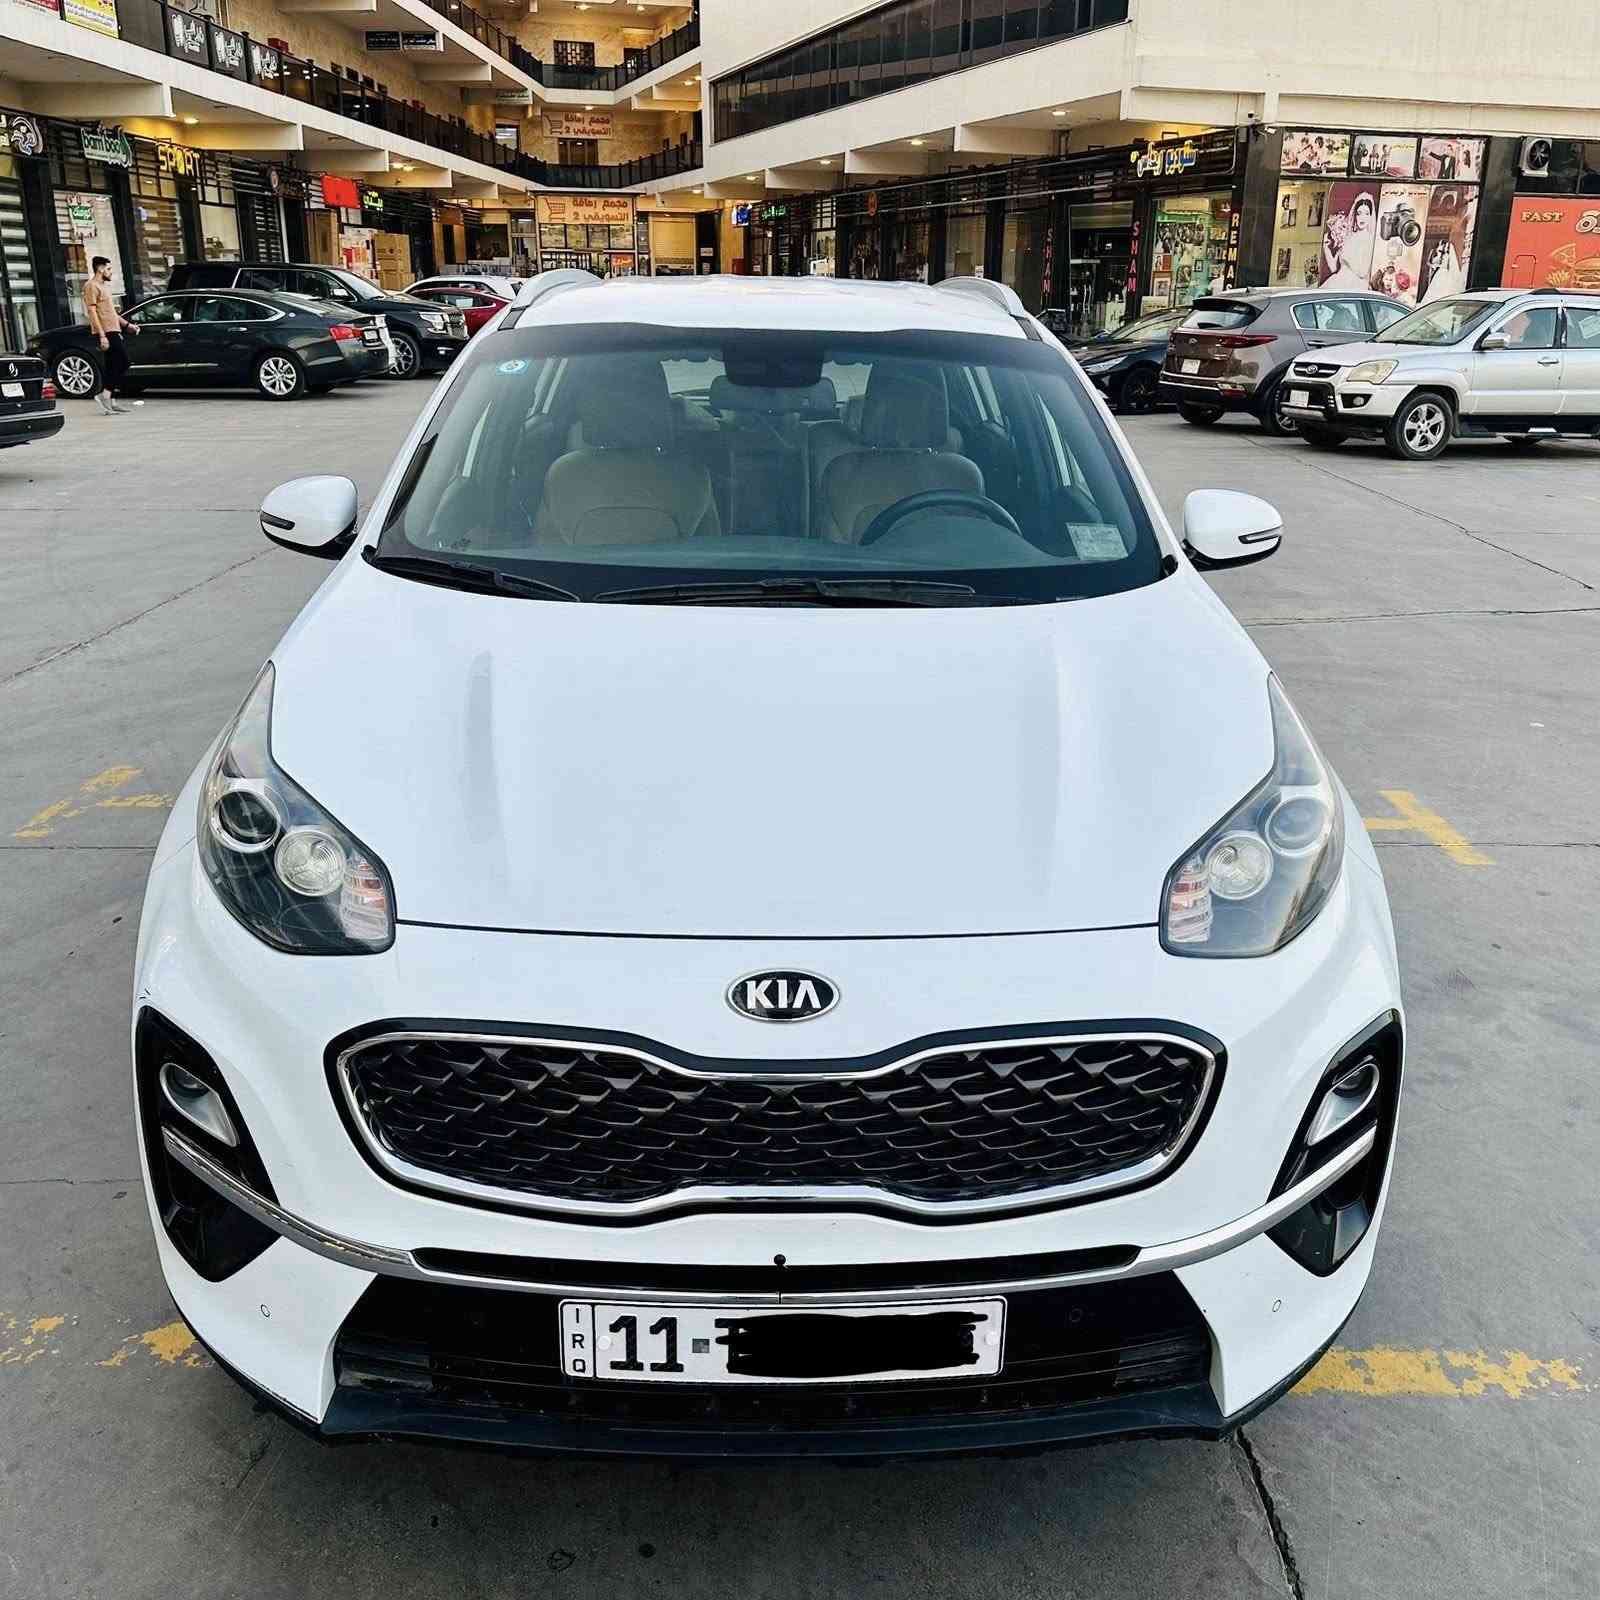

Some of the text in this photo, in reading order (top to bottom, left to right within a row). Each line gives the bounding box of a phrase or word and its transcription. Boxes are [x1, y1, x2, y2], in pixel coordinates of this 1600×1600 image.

[602, 199, 629, 211] مجمع
[1520, 210, 1563, 223] FAST
[1127, 220, 1141, 292] SHAM
[745, 979, 822, 1009] KIA
[609, 1315, 684, 1373] 11
